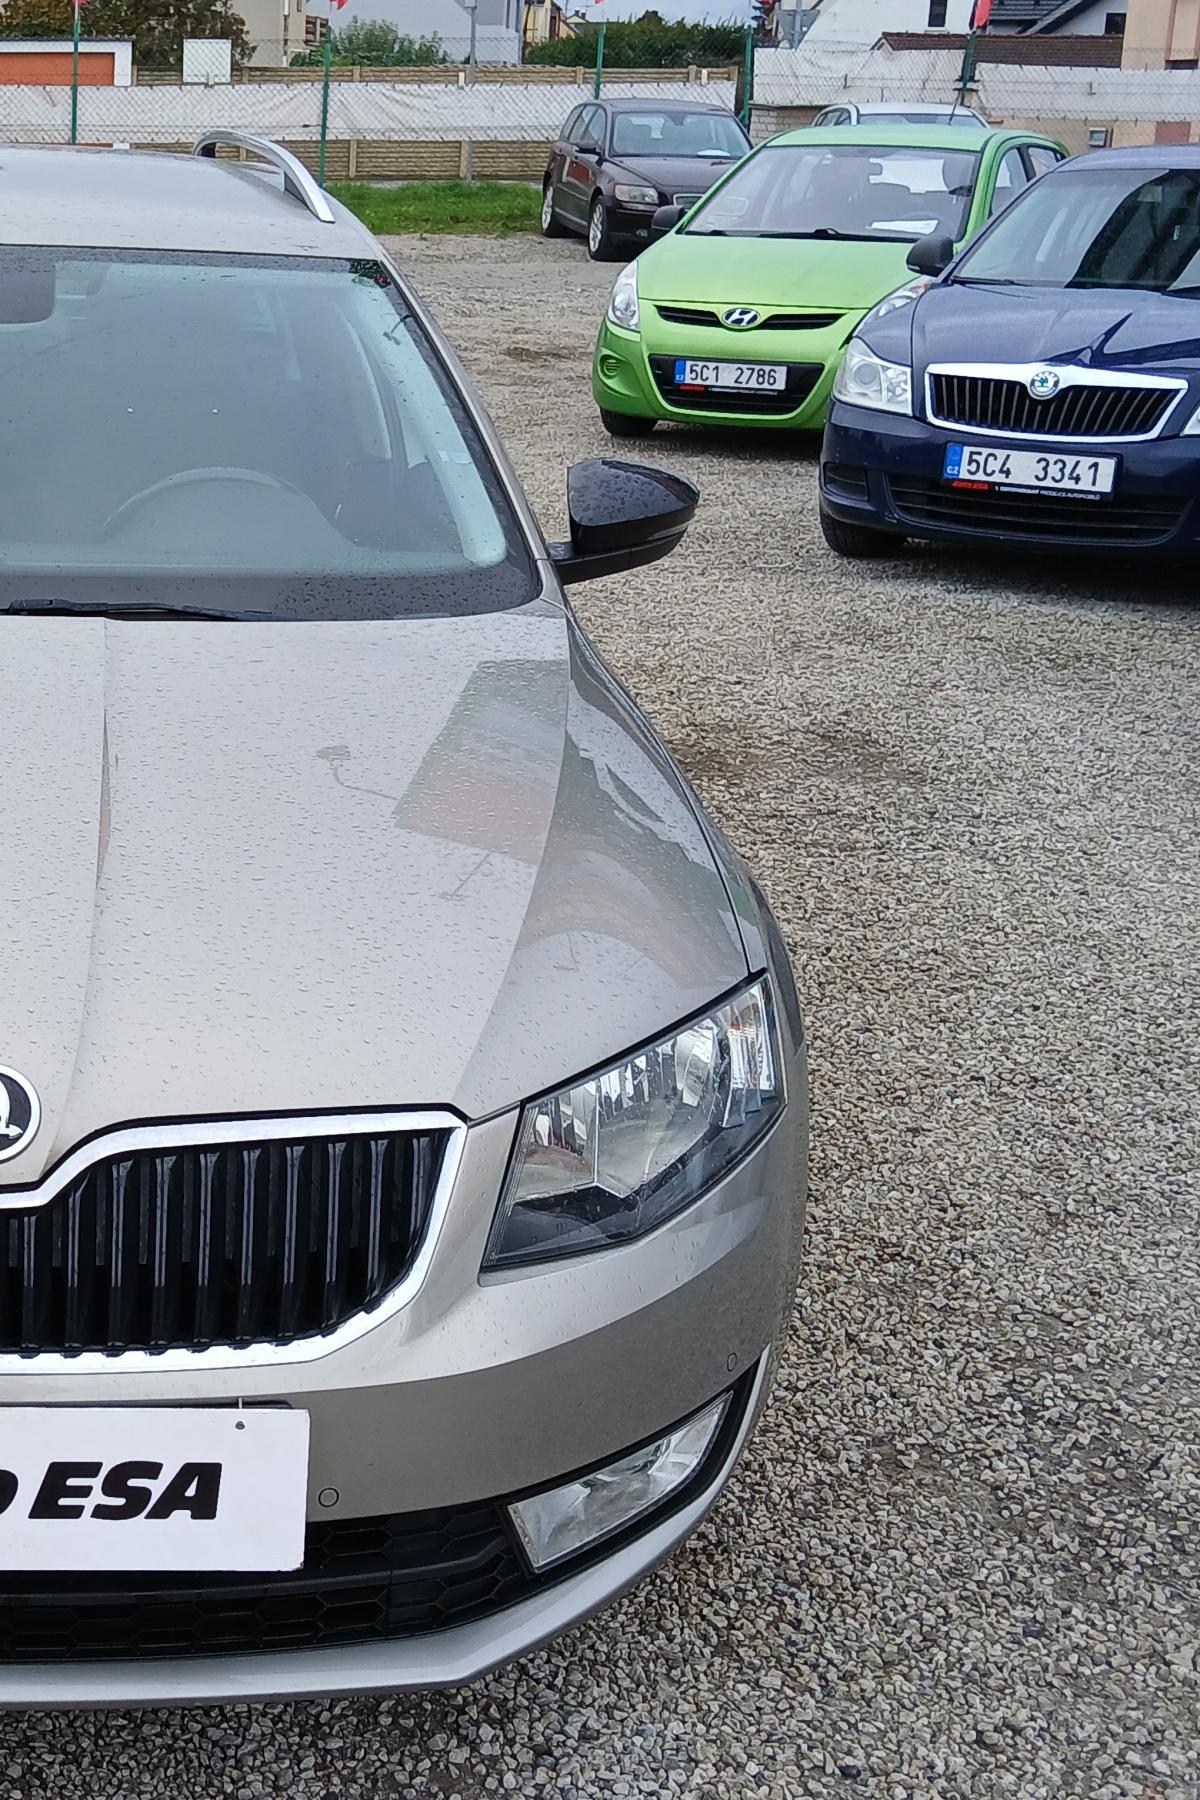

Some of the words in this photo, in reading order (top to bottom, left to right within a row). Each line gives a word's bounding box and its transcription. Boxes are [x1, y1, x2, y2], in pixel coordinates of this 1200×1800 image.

[689, 363, 720, 383] 5C1
[734, 366, 778, 386] 2786
[946, 465, 959, 475] CZ
[966, 450, 1012, 479] 5C4
[1034, 457, 1100, 487] 3341
[28, 1460, 222, 1521] ESA
